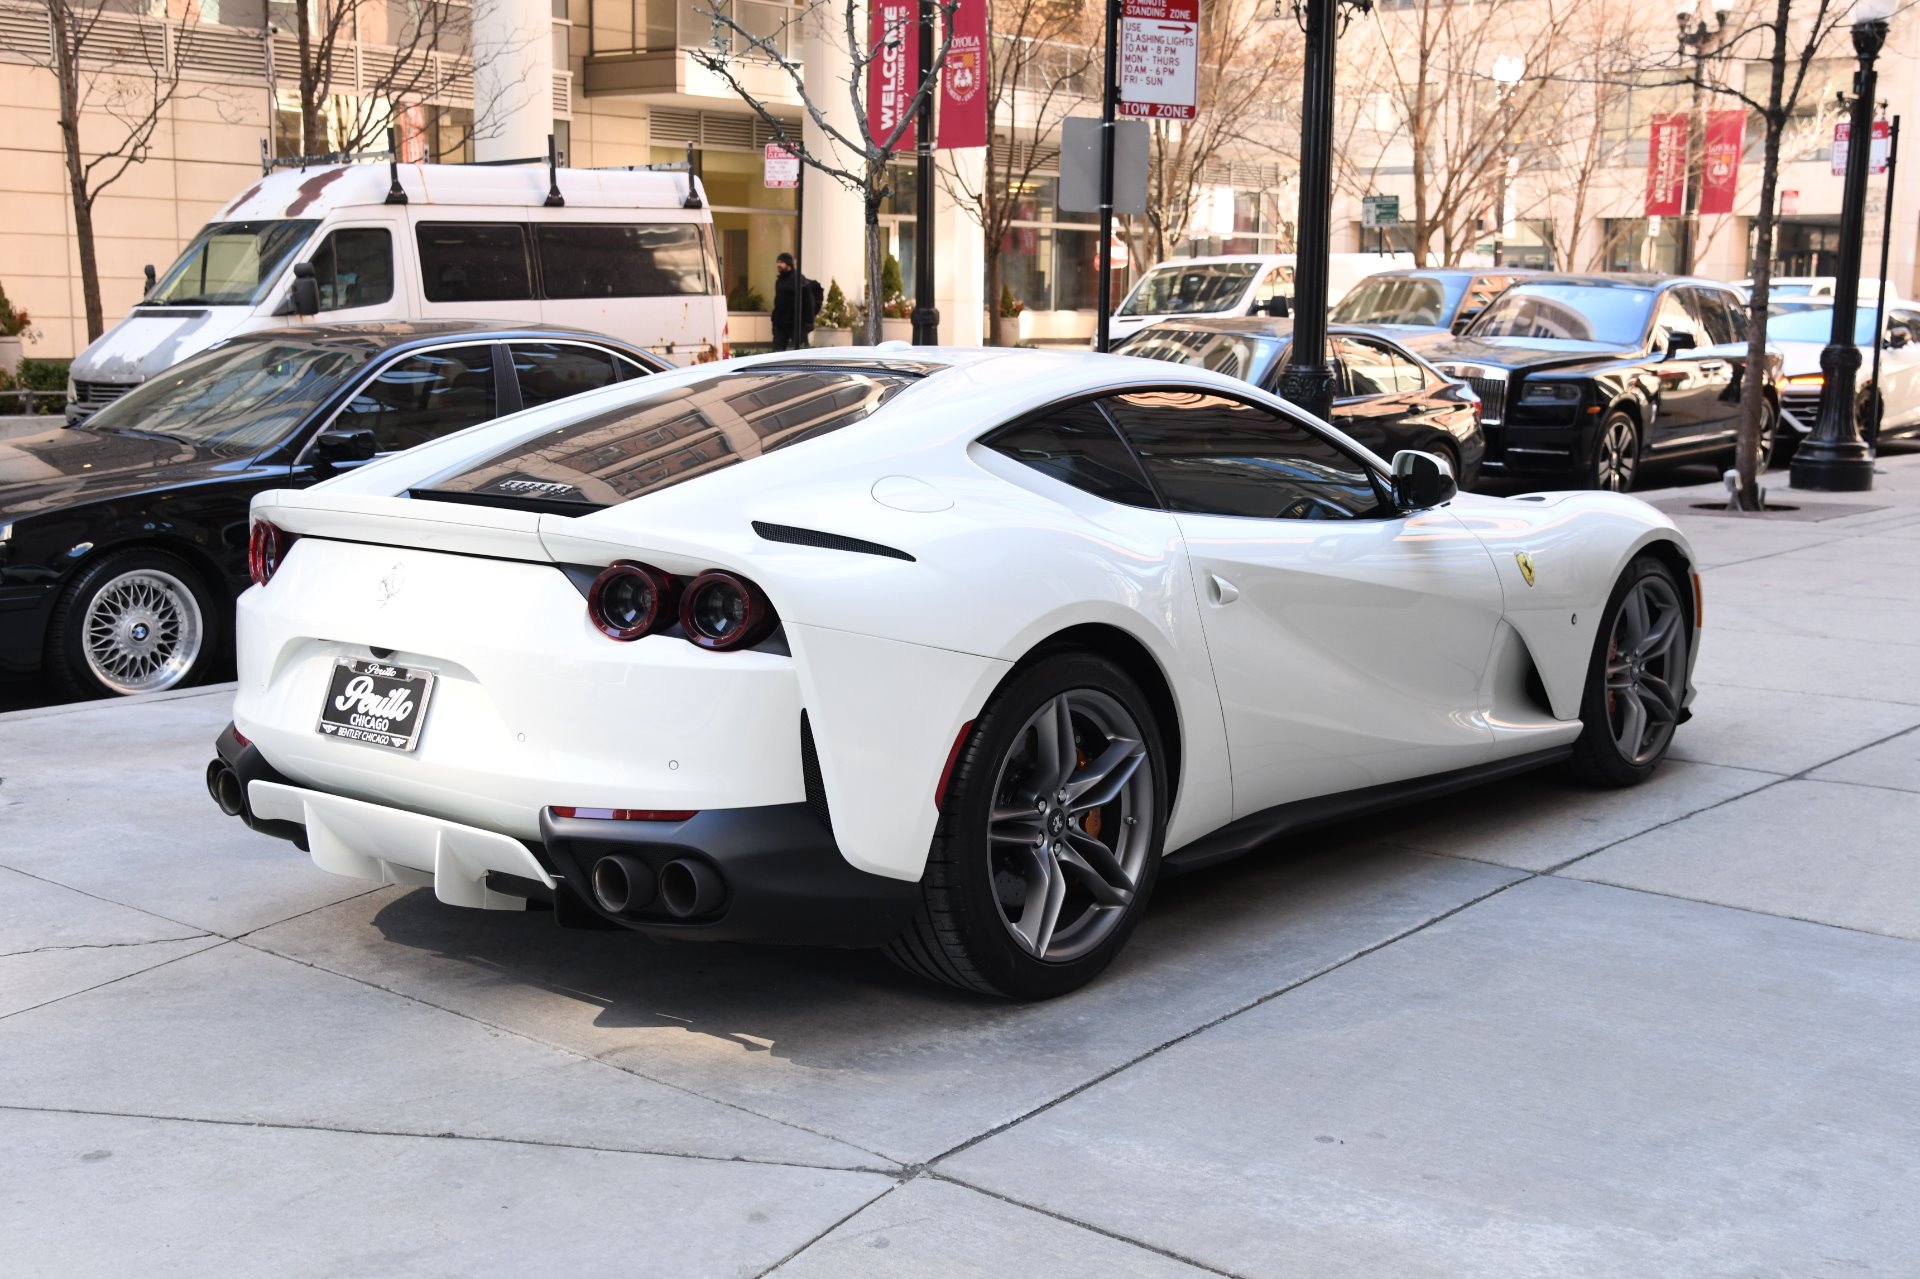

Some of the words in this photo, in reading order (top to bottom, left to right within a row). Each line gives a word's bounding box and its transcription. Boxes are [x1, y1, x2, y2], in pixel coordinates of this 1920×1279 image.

[1126, 5, 1166, 18] STANDING
[1169, 9, 1191, 20] ZONE
[1125, 23, 1142, 32] USE
[950, 36, 980, 48] OYOLA
[1125, 33, 1165, 45] FLASHING
[1167, 37, 1194, 47] LIGHTS
[1125, 44, 1134, 52] 10
[1135, 45, 1148, 53] AM
[1156, 46, 1162, 54] 8
[1164, 46, 1177, 55] PM
[1124, 54, 1143, 63] MON
[1153, 56, 1180, 67] THURS
[881, 6, 898, 131] WELCOME
[897, 55, 906, 92] TOWER
[1124, 65, 1133, 73] 10
[1134, 66, 1147, 74] AM
[1155, 67, 1161, 76] 6
[1163, 68, 1175, 76] PM
[1124, 75, 1138, 84] FRI
[1145, 77, 1163, 86] SUN
[1123, 103, 1150, 115] TOW
[1156, 105, 1189, 118] ZONE
[1654, 126, 1672, 203] WELCOME
[350, 713, 390, 732] CHICAGO
[337, 726, 362, 740] BENTLEY
[361, 731, 390, 745] CHICAGO
